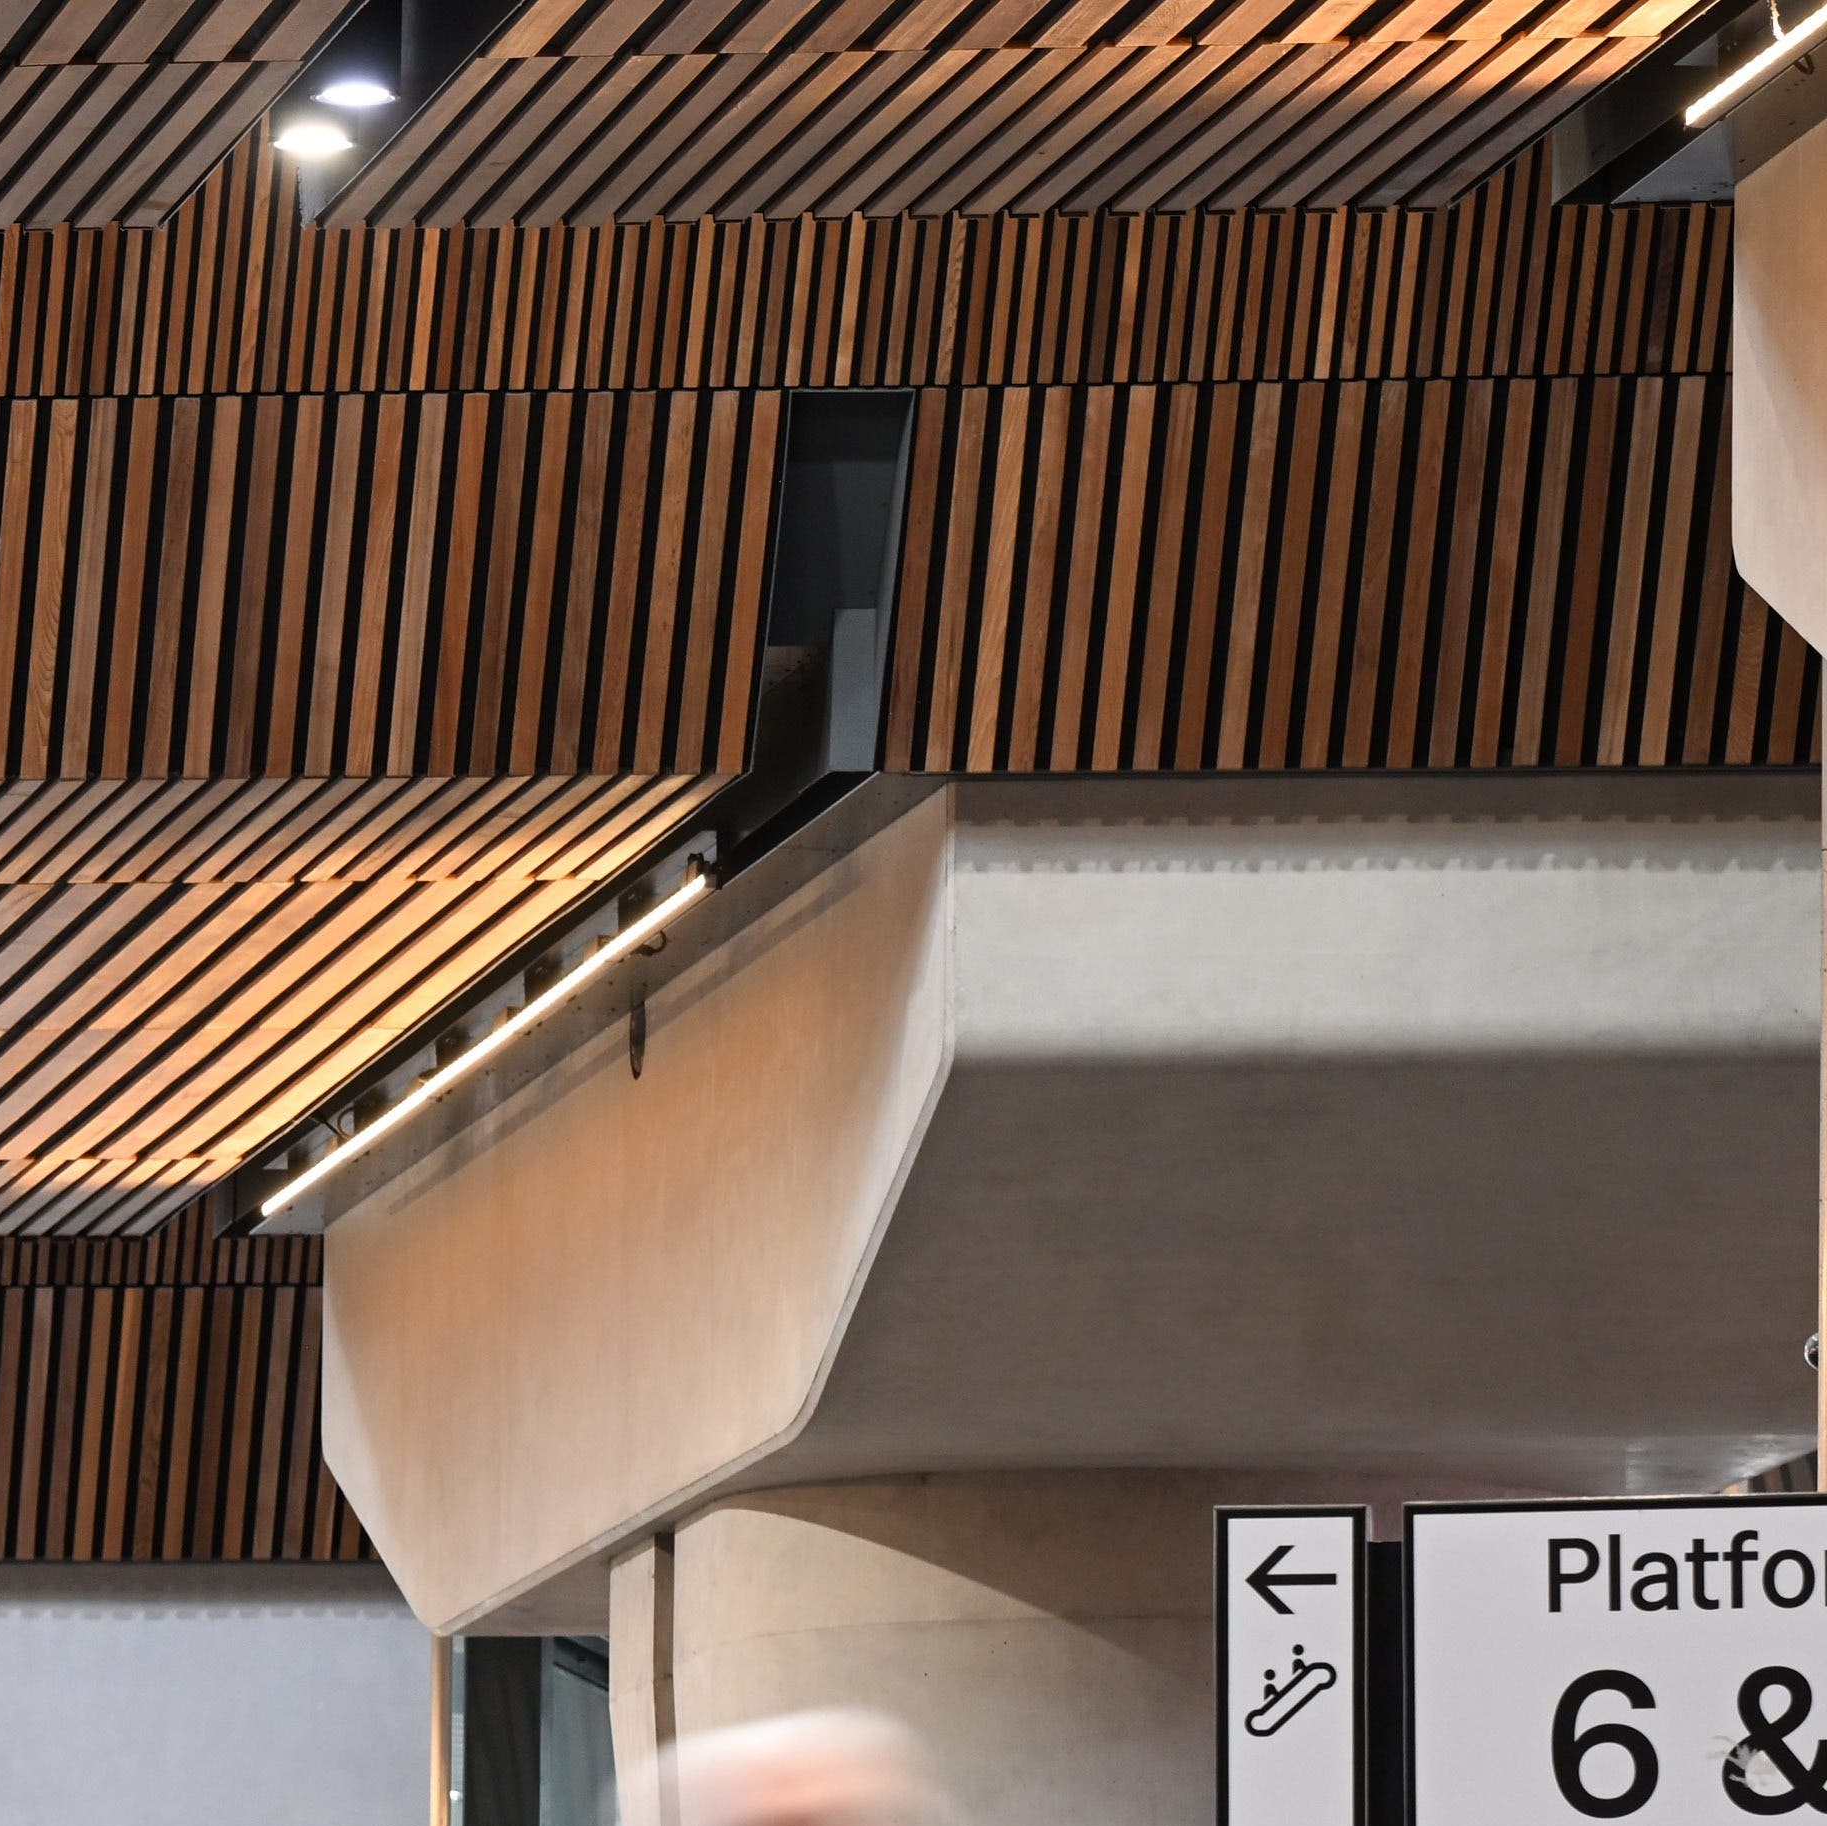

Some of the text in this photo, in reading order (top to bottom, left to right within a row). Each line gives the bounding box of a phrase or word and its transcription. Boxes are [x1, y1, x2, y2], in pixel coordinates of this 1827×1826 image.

[1547, 1529, 1827, 1613] Platfo
[1551, 1665, 1827, 1819] 6 &
